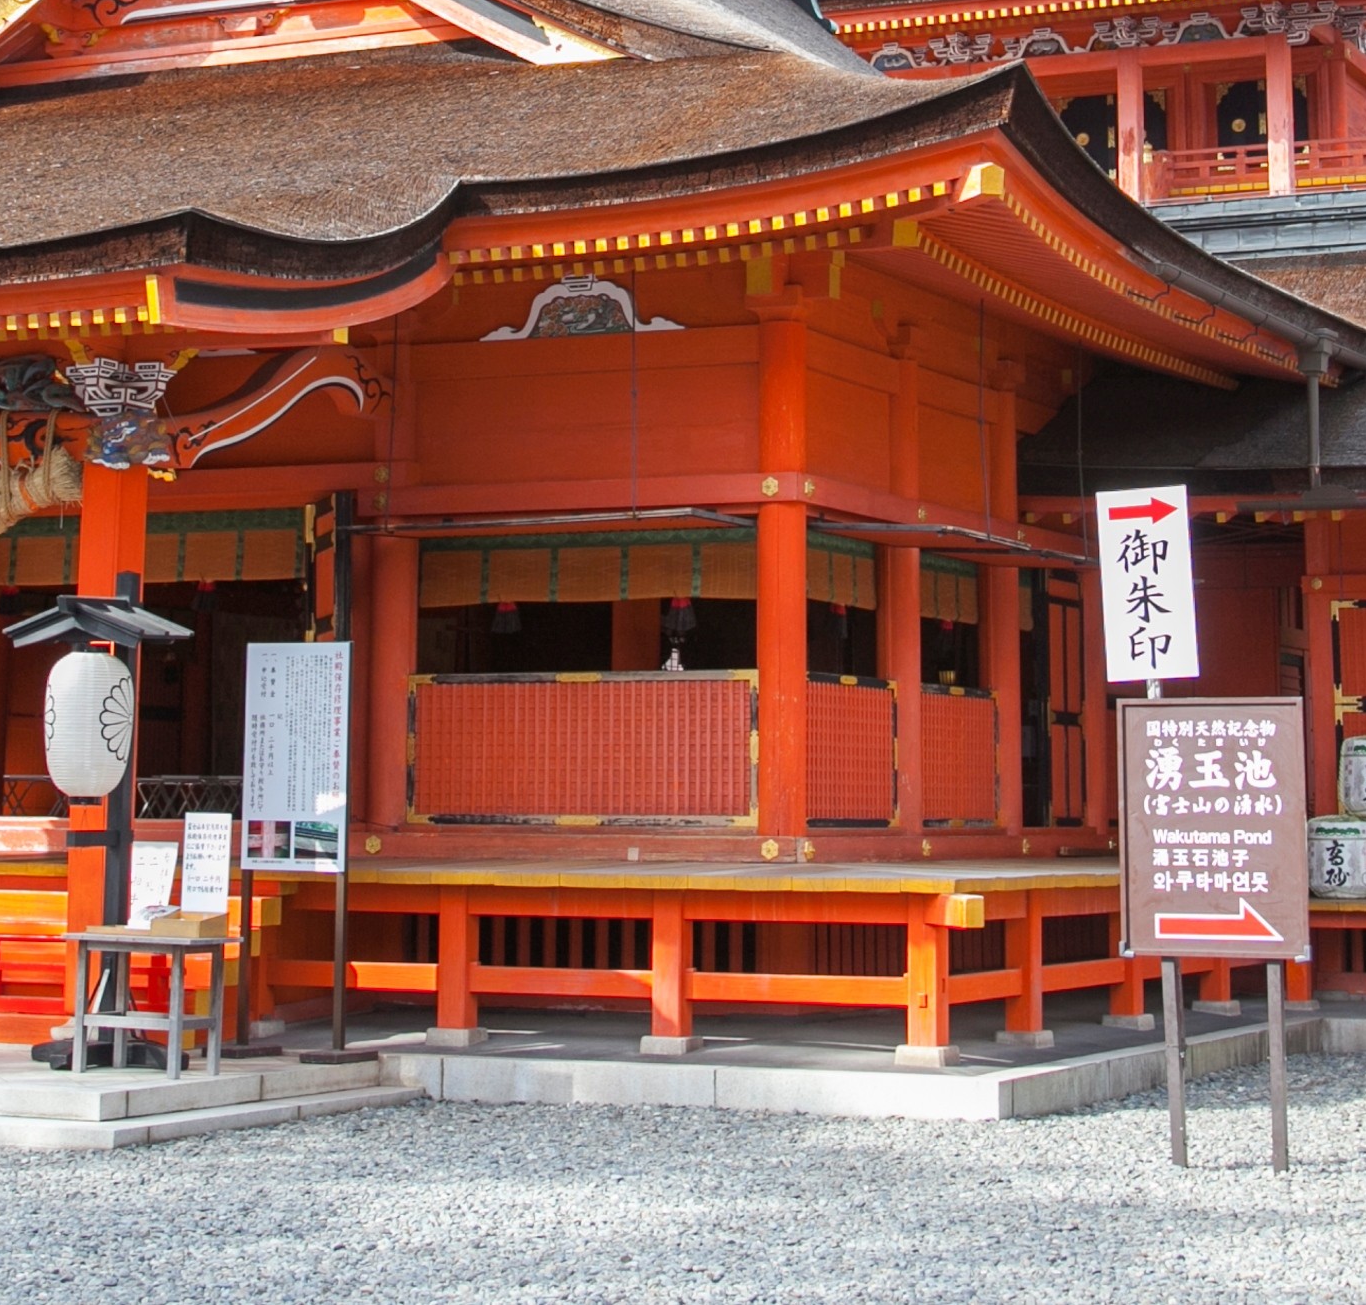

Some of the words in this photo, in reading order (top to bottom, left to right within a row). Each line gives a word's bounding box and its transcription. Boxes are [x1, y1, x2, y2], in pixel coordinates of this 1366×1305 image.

[1116, 529, 1172, 670] 御朱印
[1146, 719, 1276, 737] 国特別天然記念物
[1145, 746, 1277, 791] 湧玉池
[1152, 828, 1231, 844] Wakutama
[1233, 829, 1272, 845] Pond
[1153, 870, 1269, 892] 와쿠타마연못
